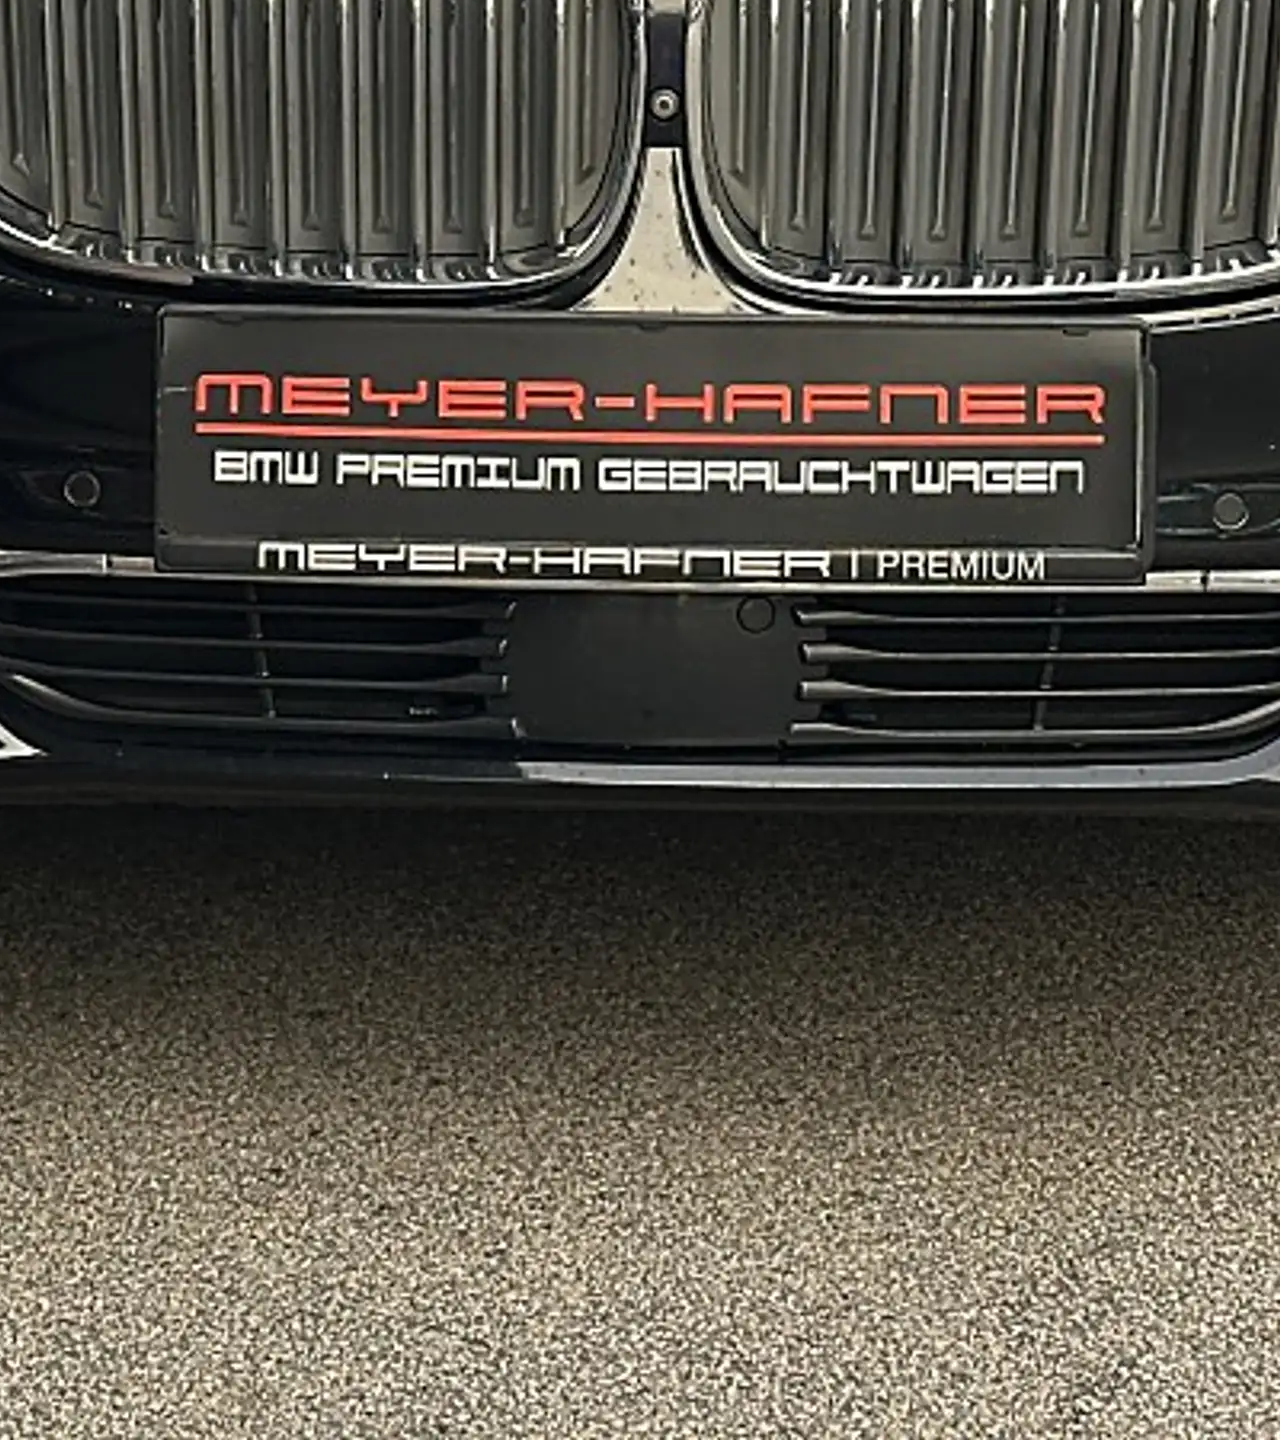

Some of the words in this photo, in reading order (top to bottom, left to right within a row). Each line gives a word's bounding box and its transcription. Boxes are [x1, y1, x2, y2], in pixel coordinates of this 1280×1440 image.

[194, 372, 1106, 424] MEYER-HAFNER
[213, 449, 319, 485] BMW
[335, 452, 581, 492] PREMIUM
[597, 458, 1085, 495] GEBRAUCHTWAGEN
[257, 541, 831, 578] MEYER-HAFNER
[876, 549, 1046, 581] PREMIUM
